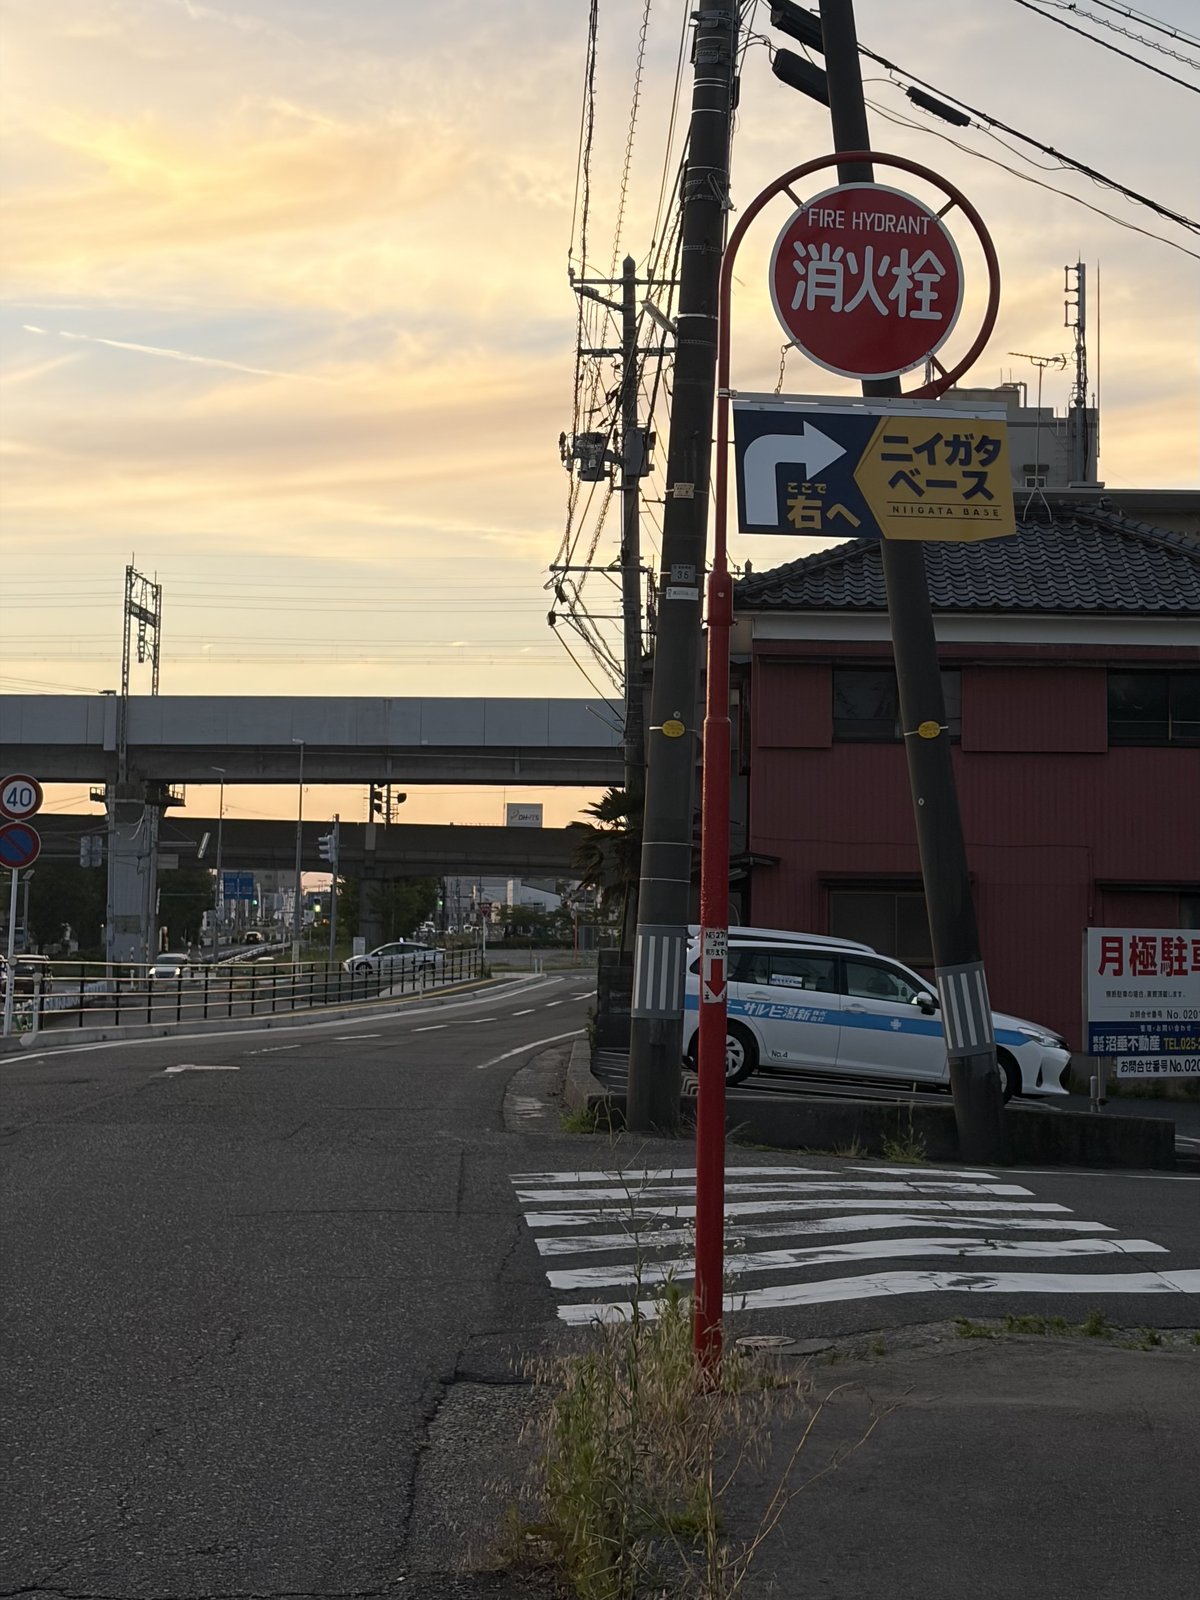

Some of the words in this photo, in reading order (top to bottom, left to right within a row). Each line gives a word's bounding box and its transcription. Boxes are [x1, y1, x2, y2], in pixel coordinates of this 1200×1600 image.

[807, 207, 845, 229] FIRE
[851, 211, 931, 236] HYDRANT
[790, 241, 947, 321] 消火栓
[880, 432, 1002, 468] ニイガタ
[787, 481, 827, 495] ここで
[888, 468, 995, 502] ベース
[786, 495, 861, 531] 右へ
[892, 505, 954, 516] NIIGATA
[963, 506, 1000, 518] BASE
[6, 787, 33, 808] 40
[771, 1049, 788, 1059] No.4
[1163, 1037, 1200, 1051] TEL.025-
[1121, 1060, 1168, 1074] お問合せ番号
